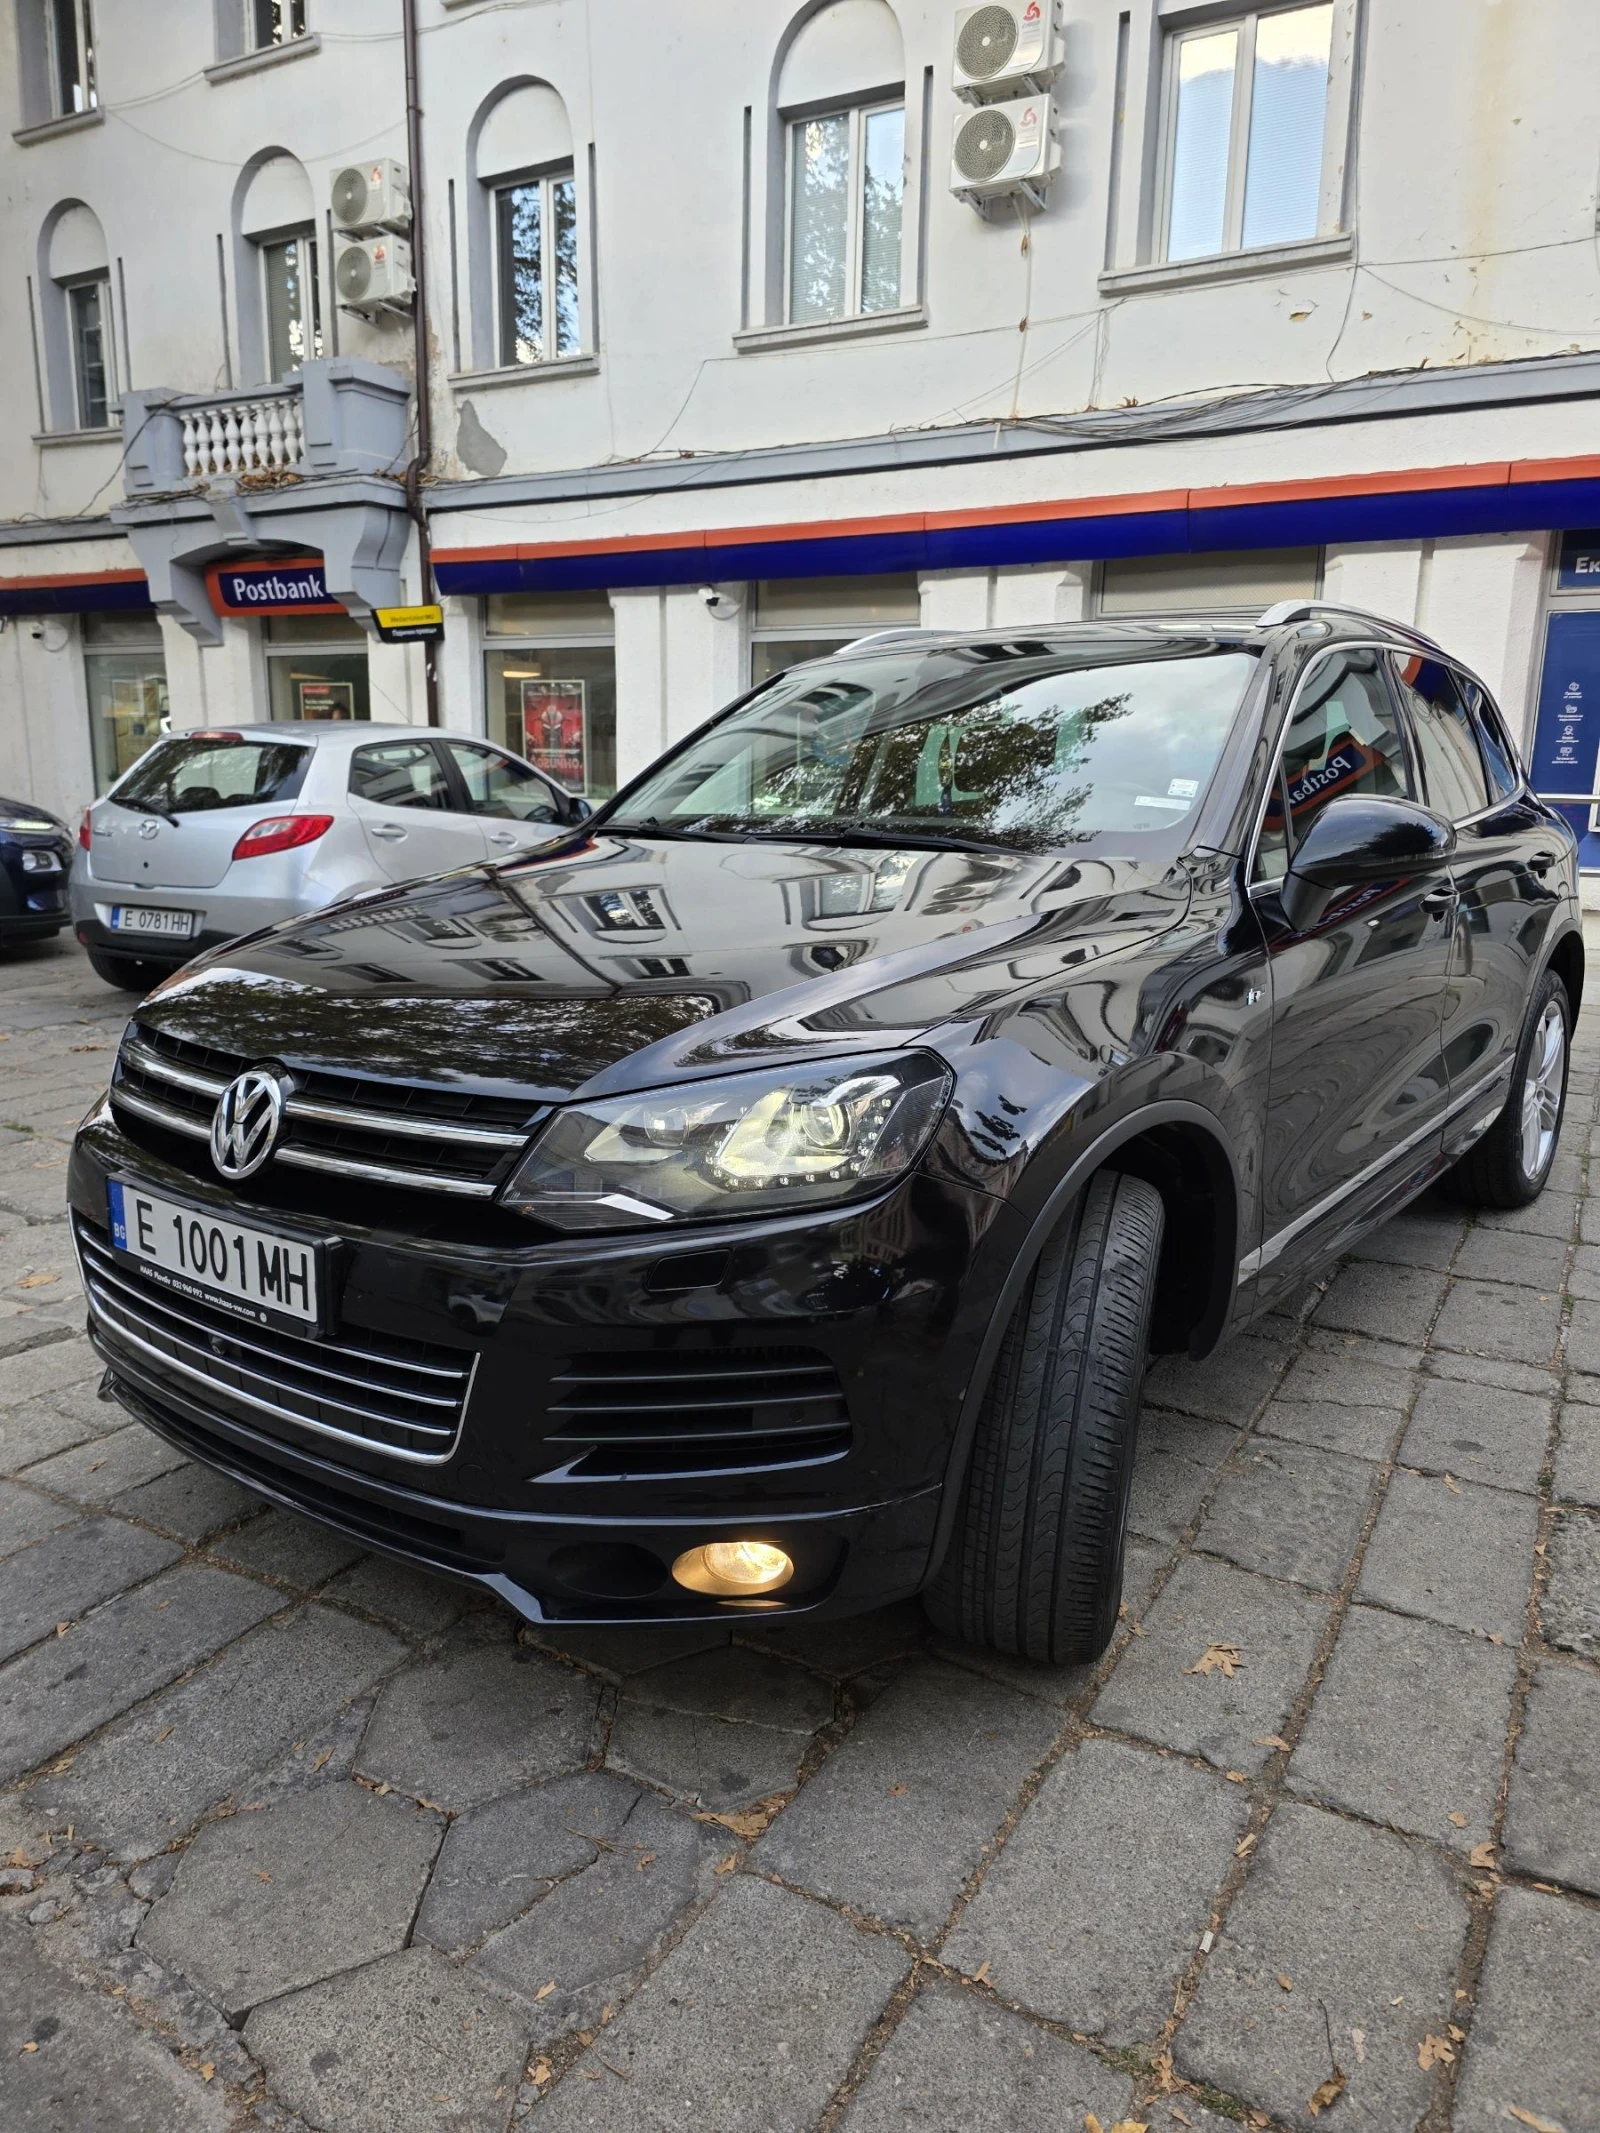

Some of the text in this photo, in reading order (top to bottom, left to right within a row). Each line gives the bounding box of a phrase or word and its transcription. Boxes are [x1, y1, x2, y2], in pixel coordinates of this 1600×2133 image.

[232, 574, 325, 602] Postbank
[124, 910, 190, 932] E 0781 HH
[114, 1221, 126, 1240] BG
[136, 1199, 309, 1311] E 1001 MH
